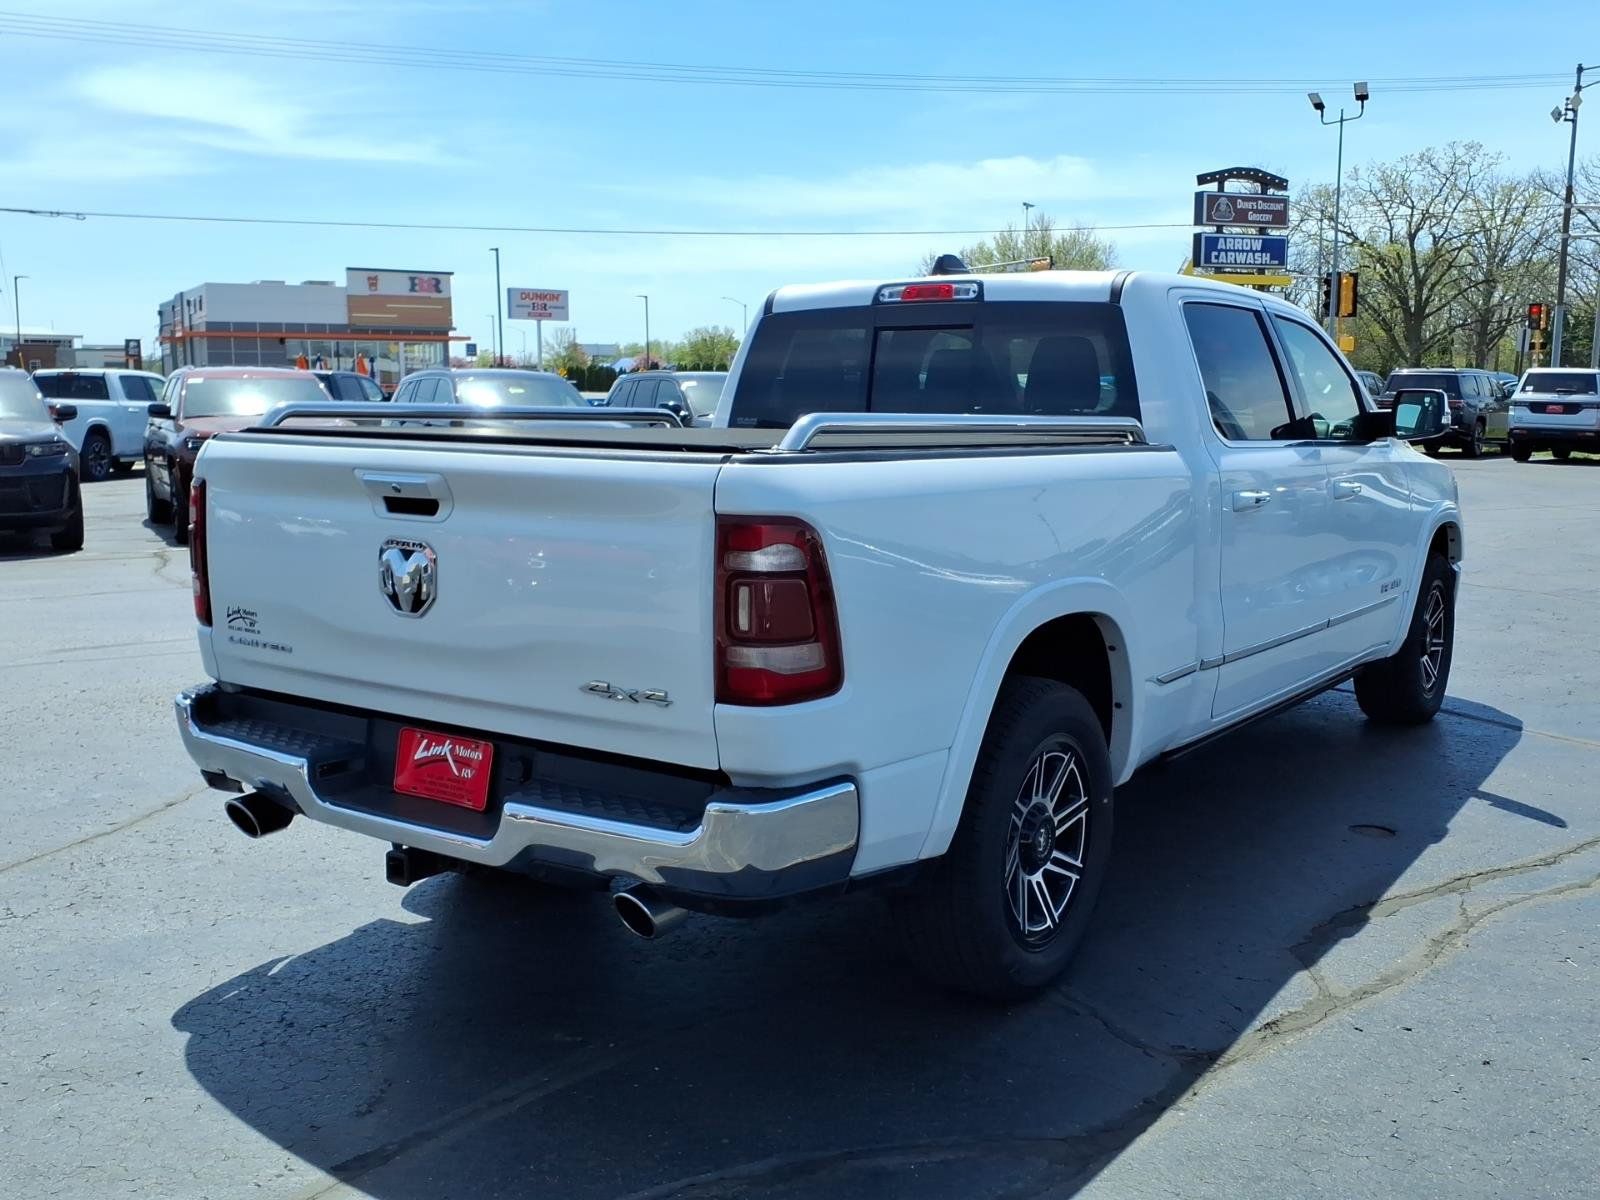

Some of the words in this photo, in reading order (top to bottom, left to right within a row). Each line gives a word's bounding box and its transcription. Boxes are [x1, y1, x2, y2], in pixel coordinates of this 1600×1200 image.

[1217, 237, 1263, 251] ARROW
[414, 738, 457, 772] Link
[453, 744, 483, 761] Motors
[460, 767, 476, 779] RV
